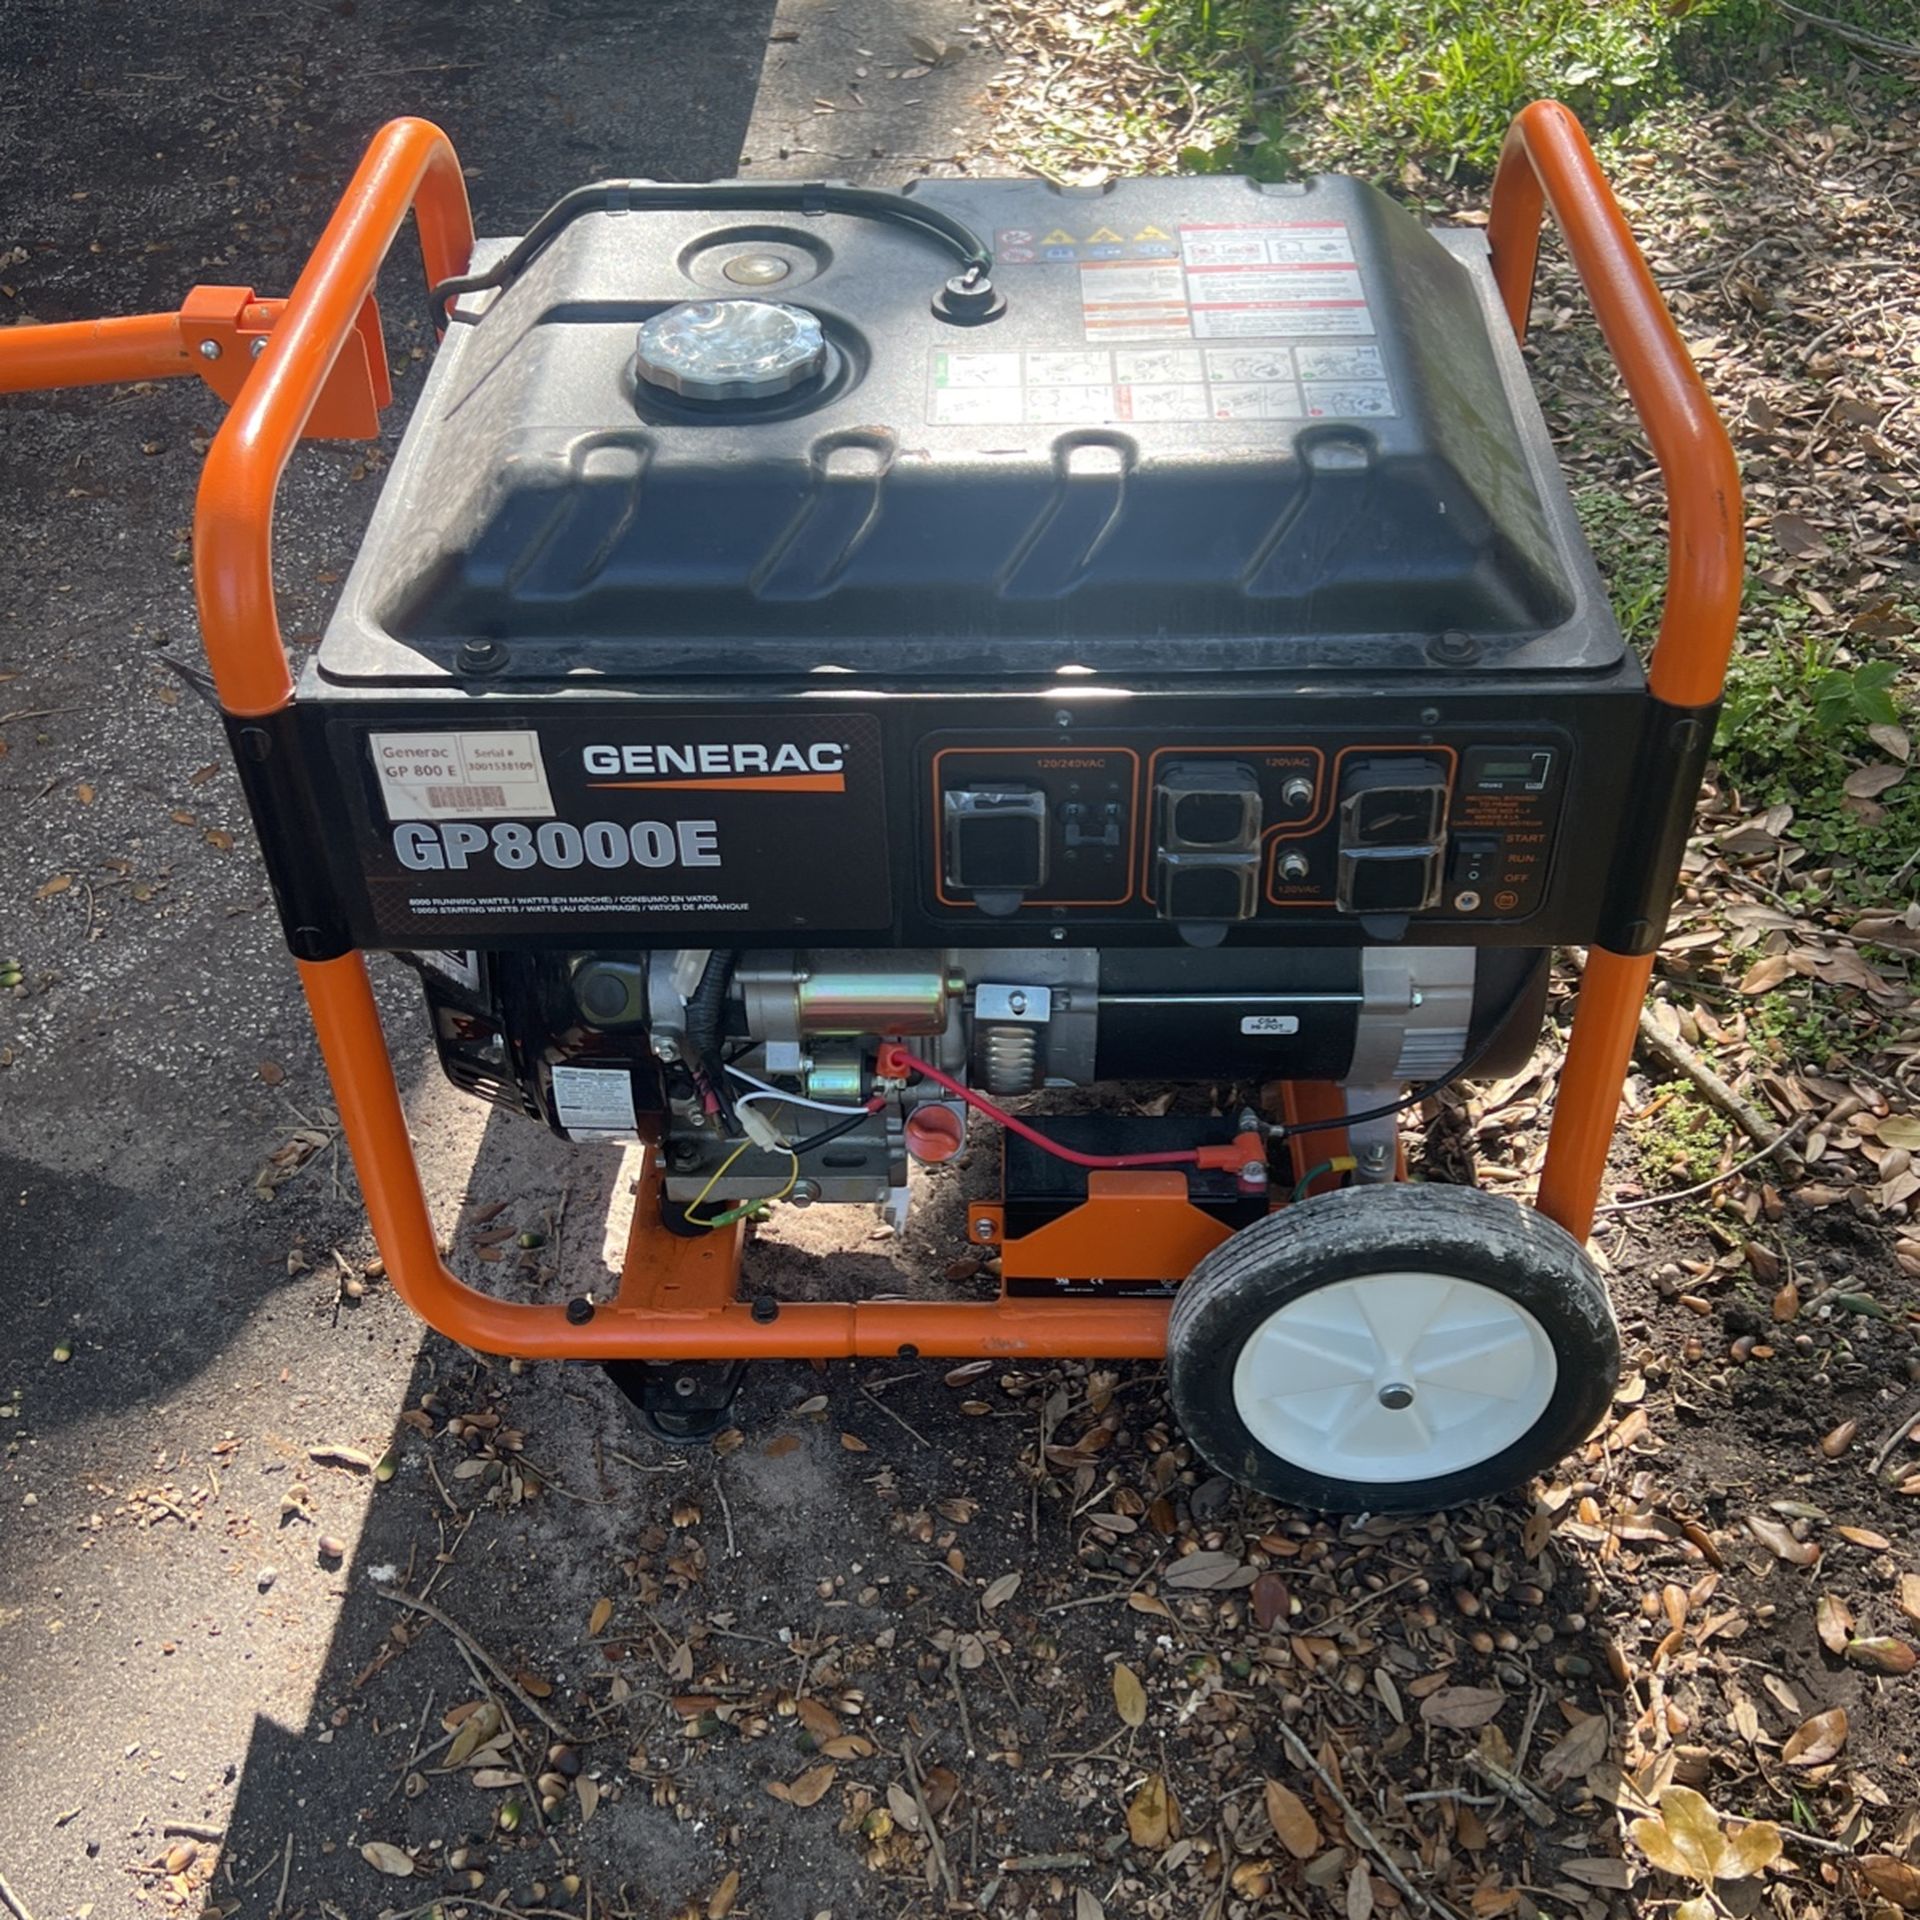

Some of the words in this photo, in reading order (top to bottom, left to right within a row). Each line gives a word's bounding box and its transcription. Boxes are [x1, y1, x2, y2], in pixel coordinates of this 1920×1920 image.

[383, 746, 449, 759] Generac
[474, 749, 505, 759] Serial
[507, 750, 514, 758] #
[583, 742, 845, 774] GENERAC
[1037, 758, 1105, 769] 120/240VAC
[1265, 757, 1310, 768] 120VAC
[385, 766, 408, 778] GP
[414, 765, 443, 777] 800
[448, 766, 457, 777] E
[1505, 834, 1545, 843] START
[393, 821, 721, 870] GP8000E
[1507, 854, 1535, 863] RUN
[1504, 873, 1528, 883] OFF
[1278, 885, 1321, 895] 120VAC
[432, 898, 477, 906] RUNNING
[478, 897, 510, 905] WATTS
[517, 896, 550, 905] WATTS
[619, 896, 669, 904] CONSUMO
[671, 895, 684, 903] EN
[685, 895, 719, 903] VATIOS
[439, 906, 486, 914] STARTING
[487, 906, 519, 914] WATTS
[526, 905, 558, 913] WATTS
[647, 903, 681, 911] VATIOS
[682, 903, 695, 911] DE
[697, 903, 749, 911] ARRANQUE
